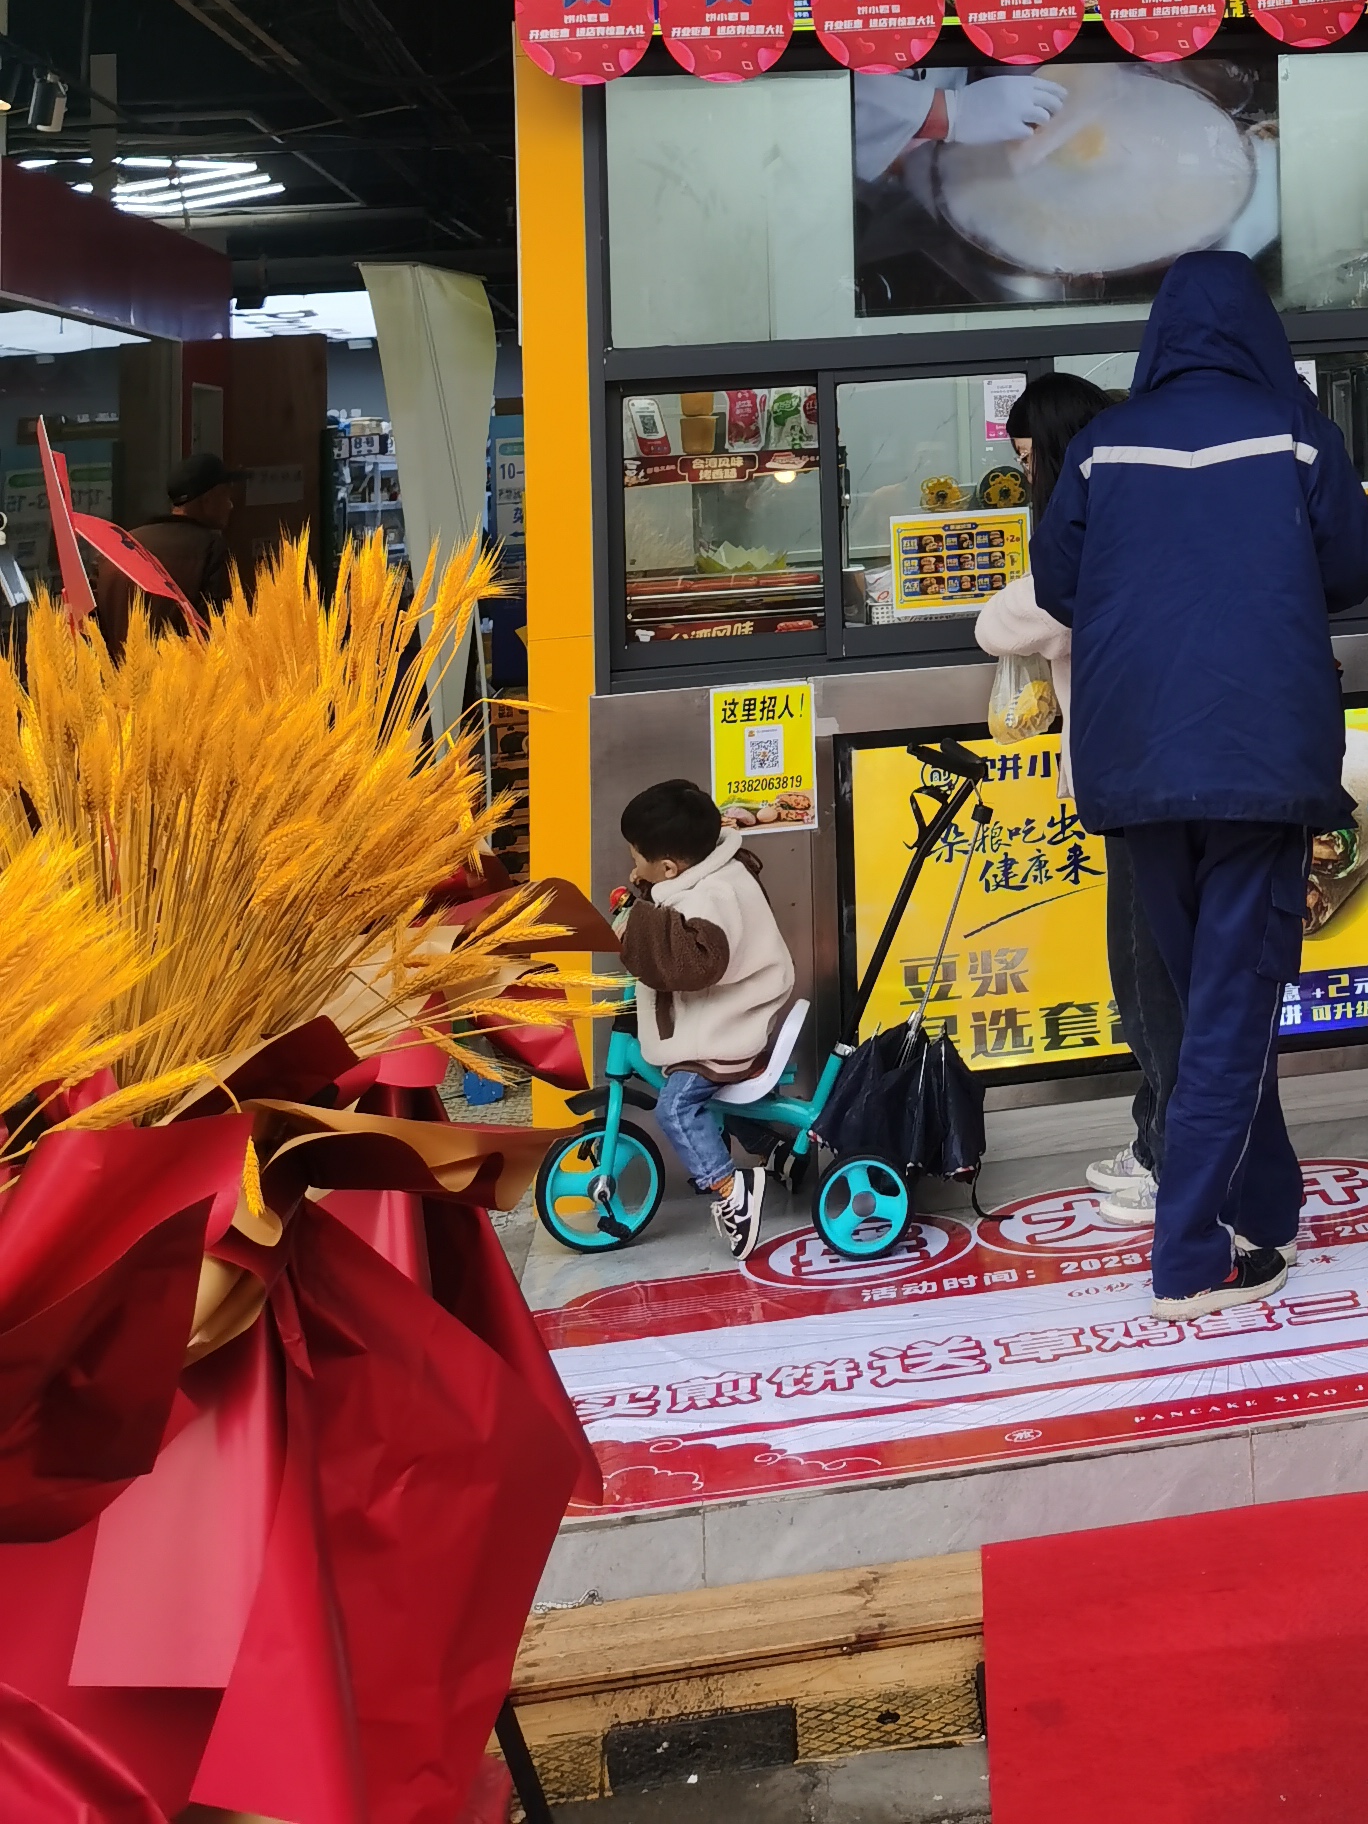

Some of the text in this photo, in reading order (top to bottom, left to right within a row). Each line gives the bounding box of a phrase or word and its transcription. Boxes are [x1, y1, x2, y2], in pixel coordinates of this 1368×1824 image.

[727, 774, 803, 794] 13382063819
[978, 843, 1106, 893] 健康来
[900, 948, 1029, 1005] 豆浆
[1134, 1398, 1258, 1423] PANCAKE
[1275, 1387, 1338, 1404] XIAO
